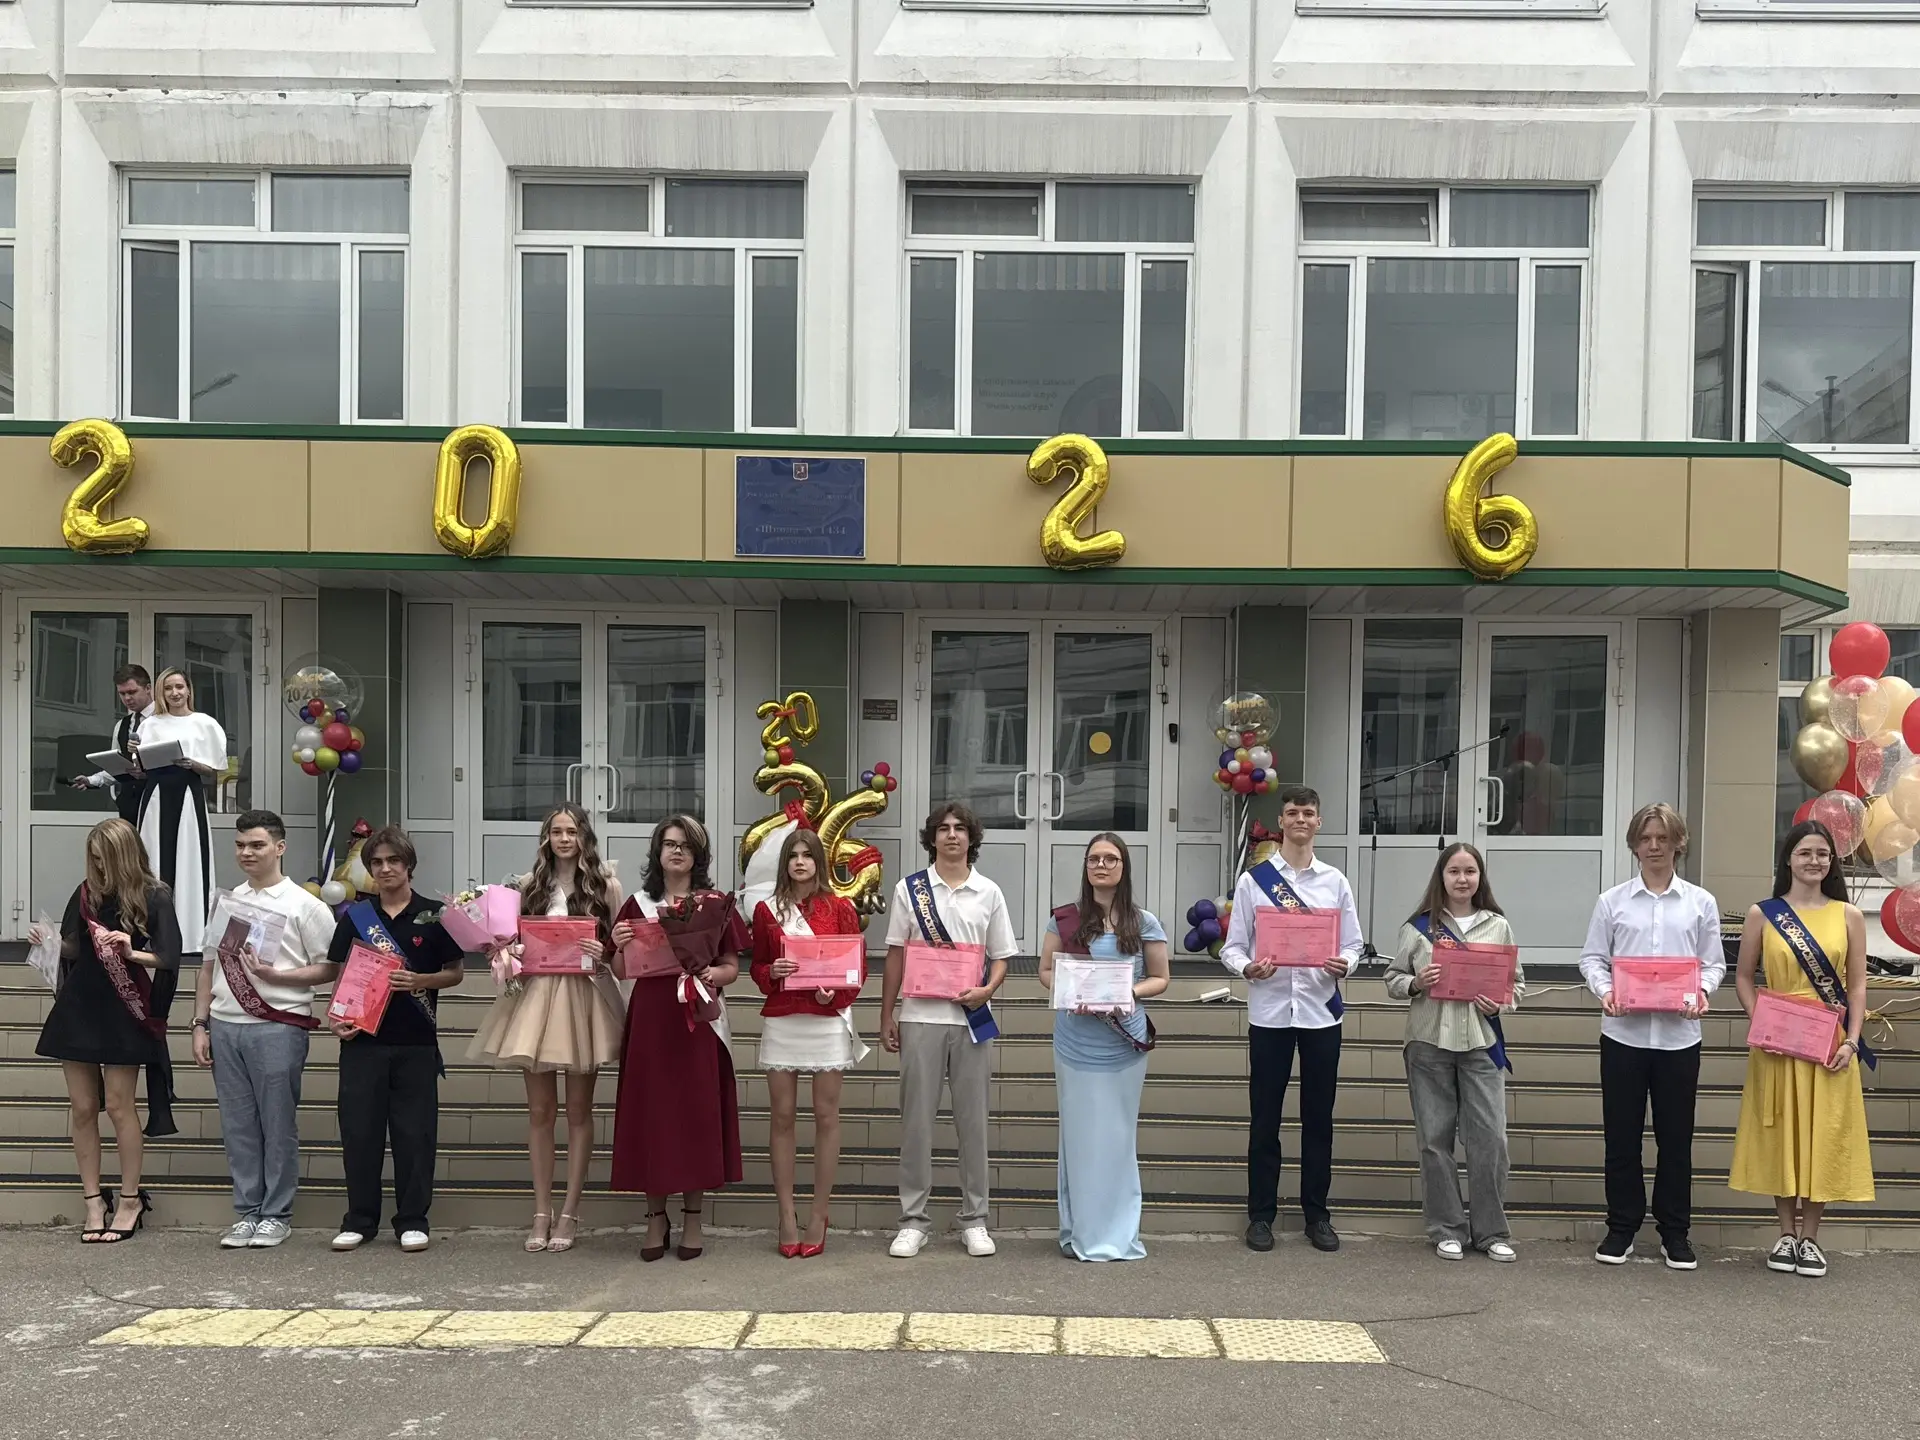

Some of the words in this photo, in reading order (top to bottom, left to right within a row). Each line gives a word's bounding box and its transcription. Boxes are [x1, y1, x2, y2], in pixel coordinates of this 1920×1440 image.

[50, 421, 150, 557] 2
[432, 426, 522, 560] 0
[1026, 434, 1126, 570] 2
[1443, 432, 1538, 580] 6
